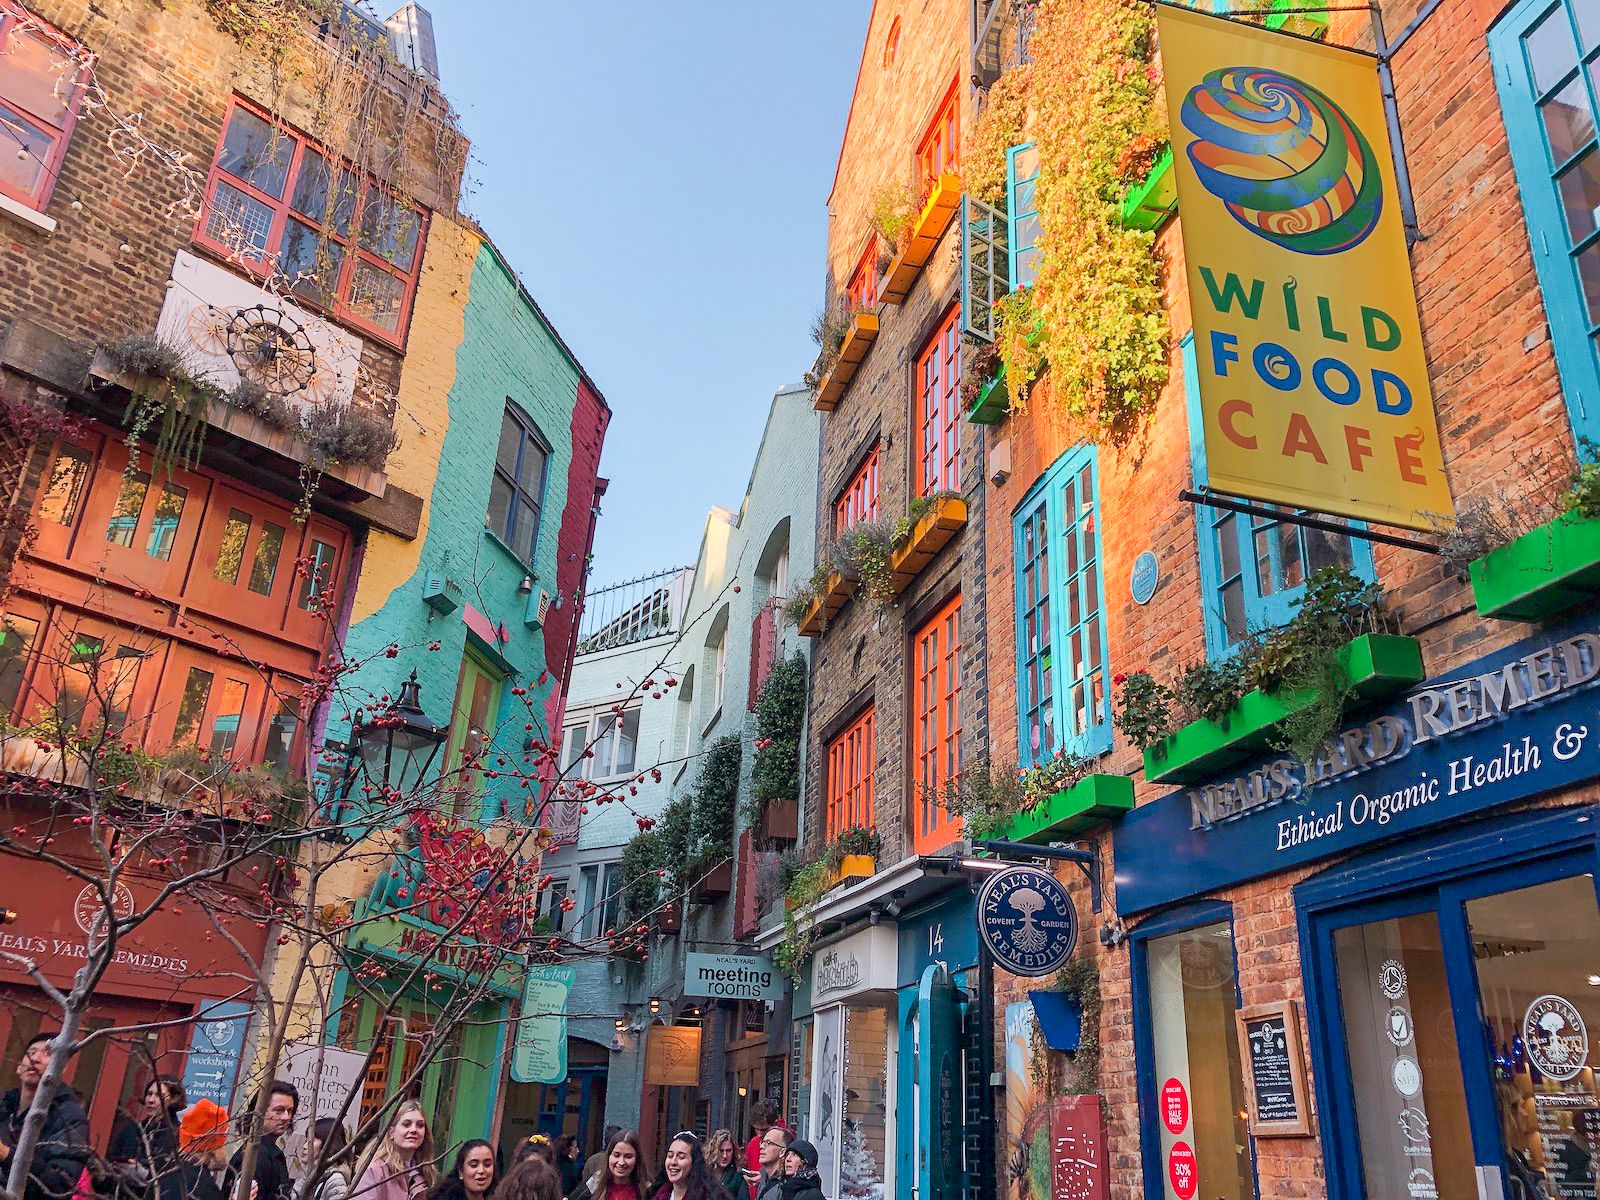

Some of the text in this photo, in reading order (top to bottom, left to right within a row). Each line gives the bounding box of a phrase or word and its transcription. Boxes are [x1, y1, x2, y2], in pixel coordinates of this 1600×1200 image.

[1198, 265, 1402, 352] WILD
[1210, 330, 1413, 416] FOOD
[1276, 723, 1588, 851] Ethical Organic Health &
[987, 874, 1067, 916] NEAL'S YARD
[986, 917, 1070, 928] COVENT GARDEN
[52, 939, 90, 960] YAR
[929, 923, 944, 956] 14
[990, 930, 1068, 966] REMEDIES
[699, 967, 772, 988] meeting
[708, 982, 761, 997] rooms
[192, 1056, 234, 1068] workshops
[293, 1076, 347, 1096] maters
[1174, 1163, 1192, 1177] 30%
[1178, 1176, 1189, 1189] off
